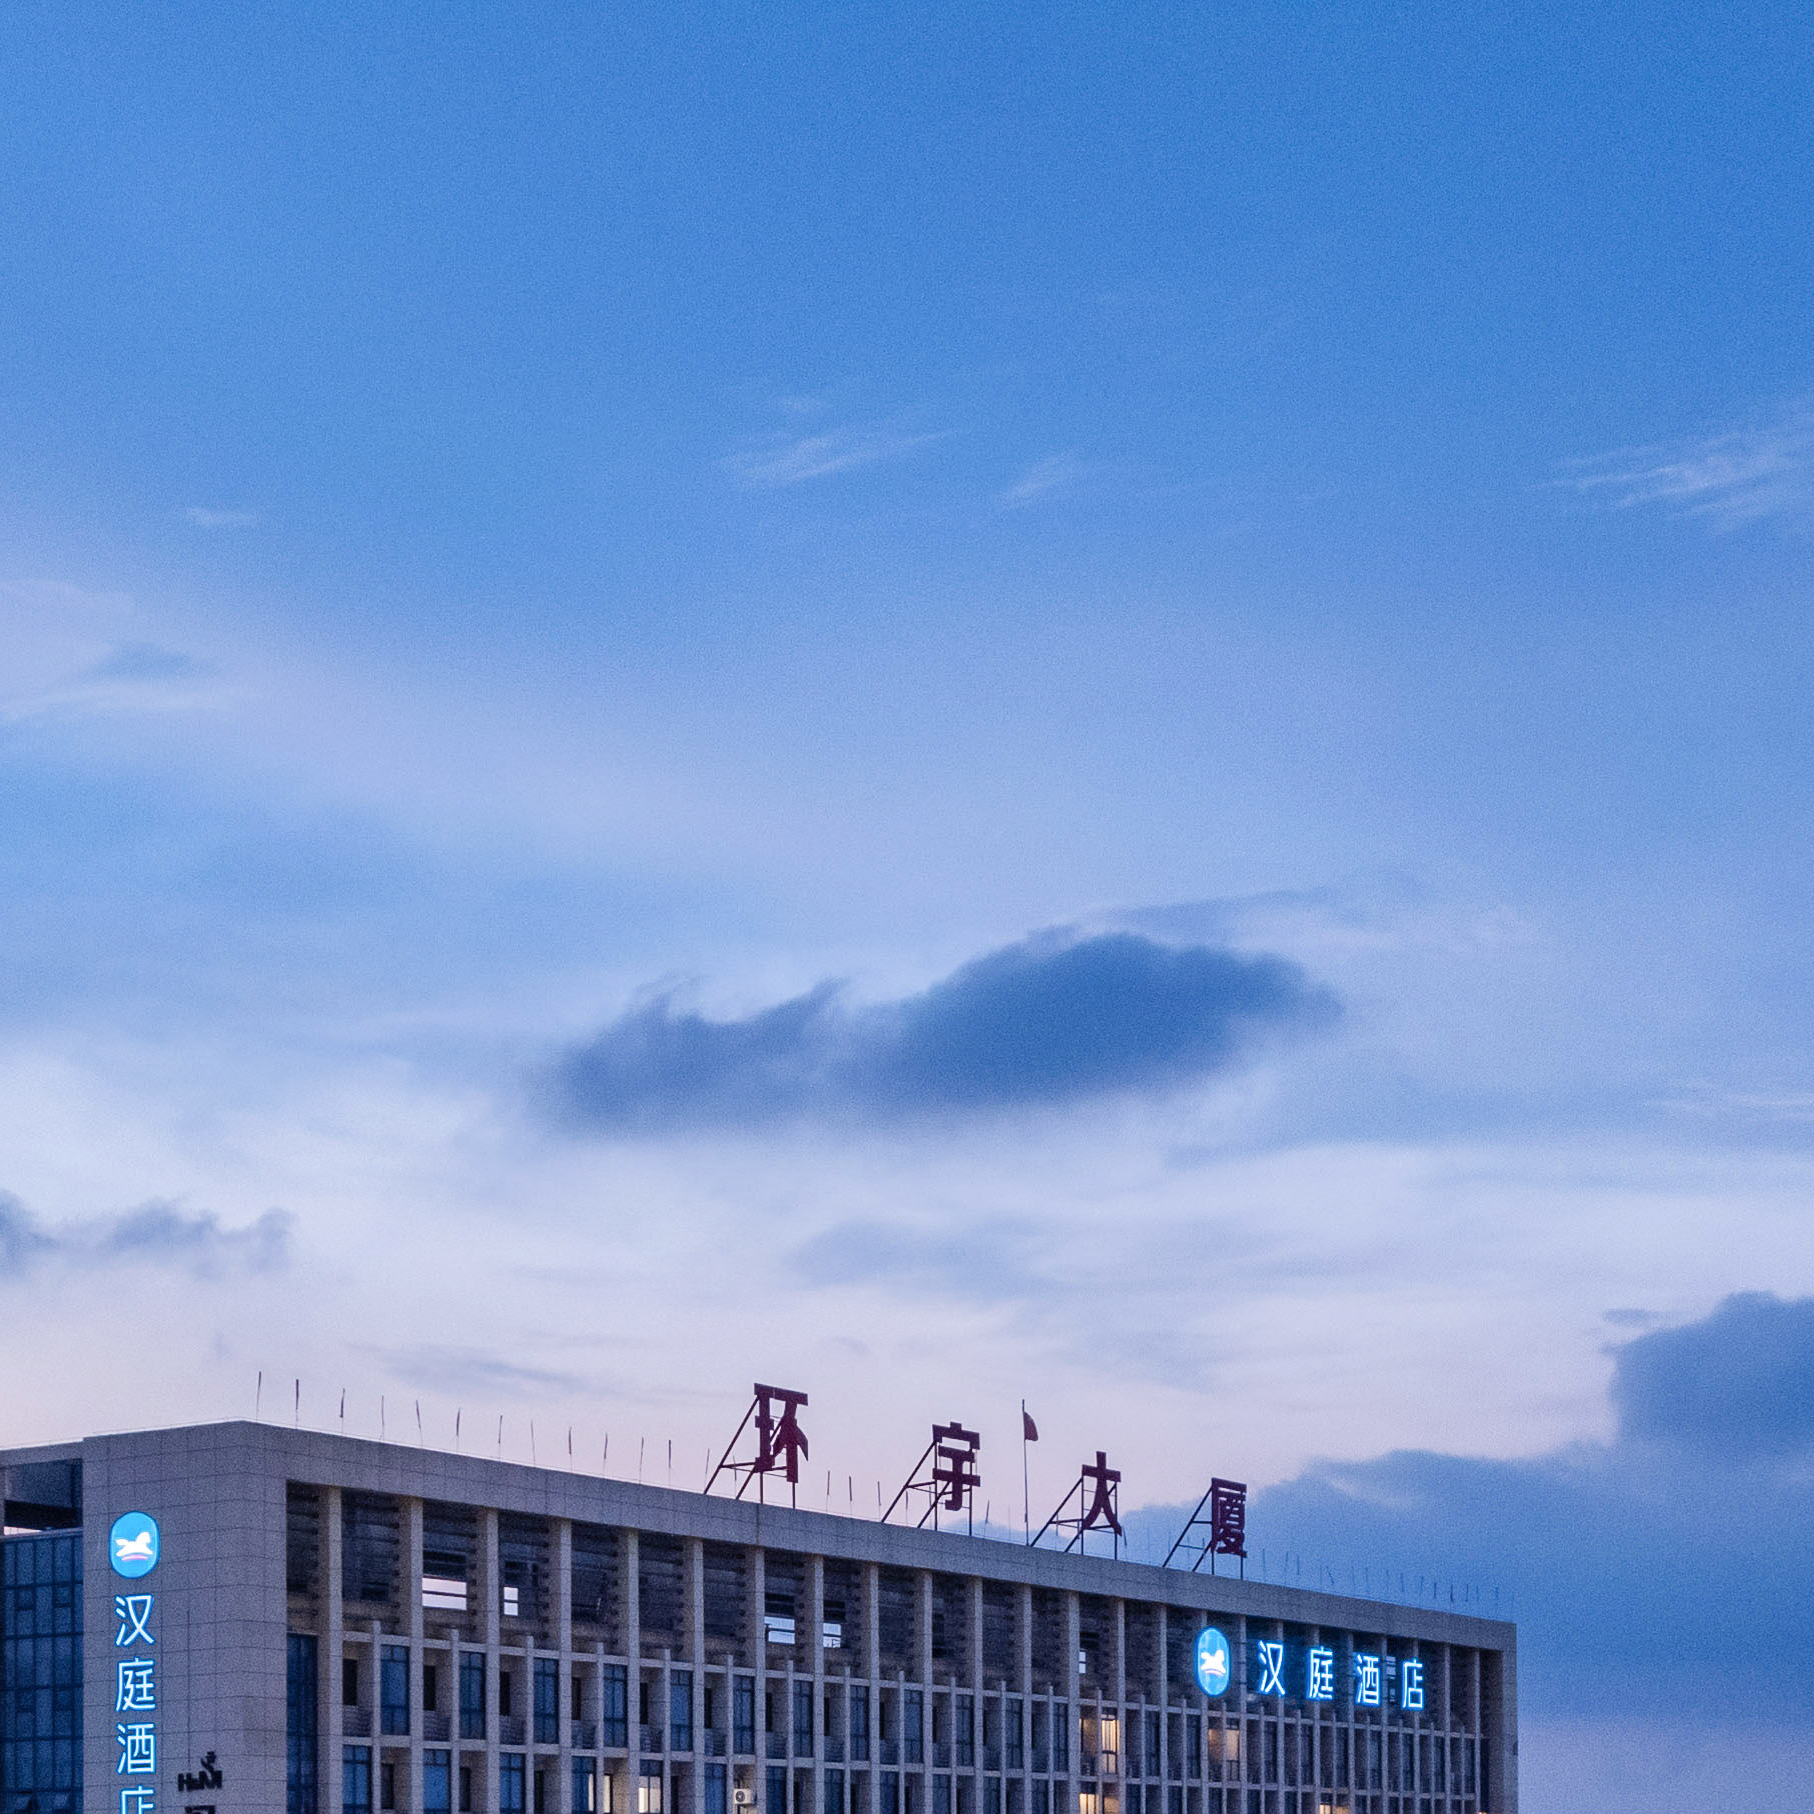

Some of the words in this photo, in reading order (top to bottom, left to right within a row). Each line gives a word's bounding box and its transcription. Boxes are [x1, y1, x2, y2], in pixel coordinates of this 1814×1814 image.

[754, 1383, 1247, 1558] 环宇大厦
[1257, 1640, 1426, 1710] 汉庭酒店
